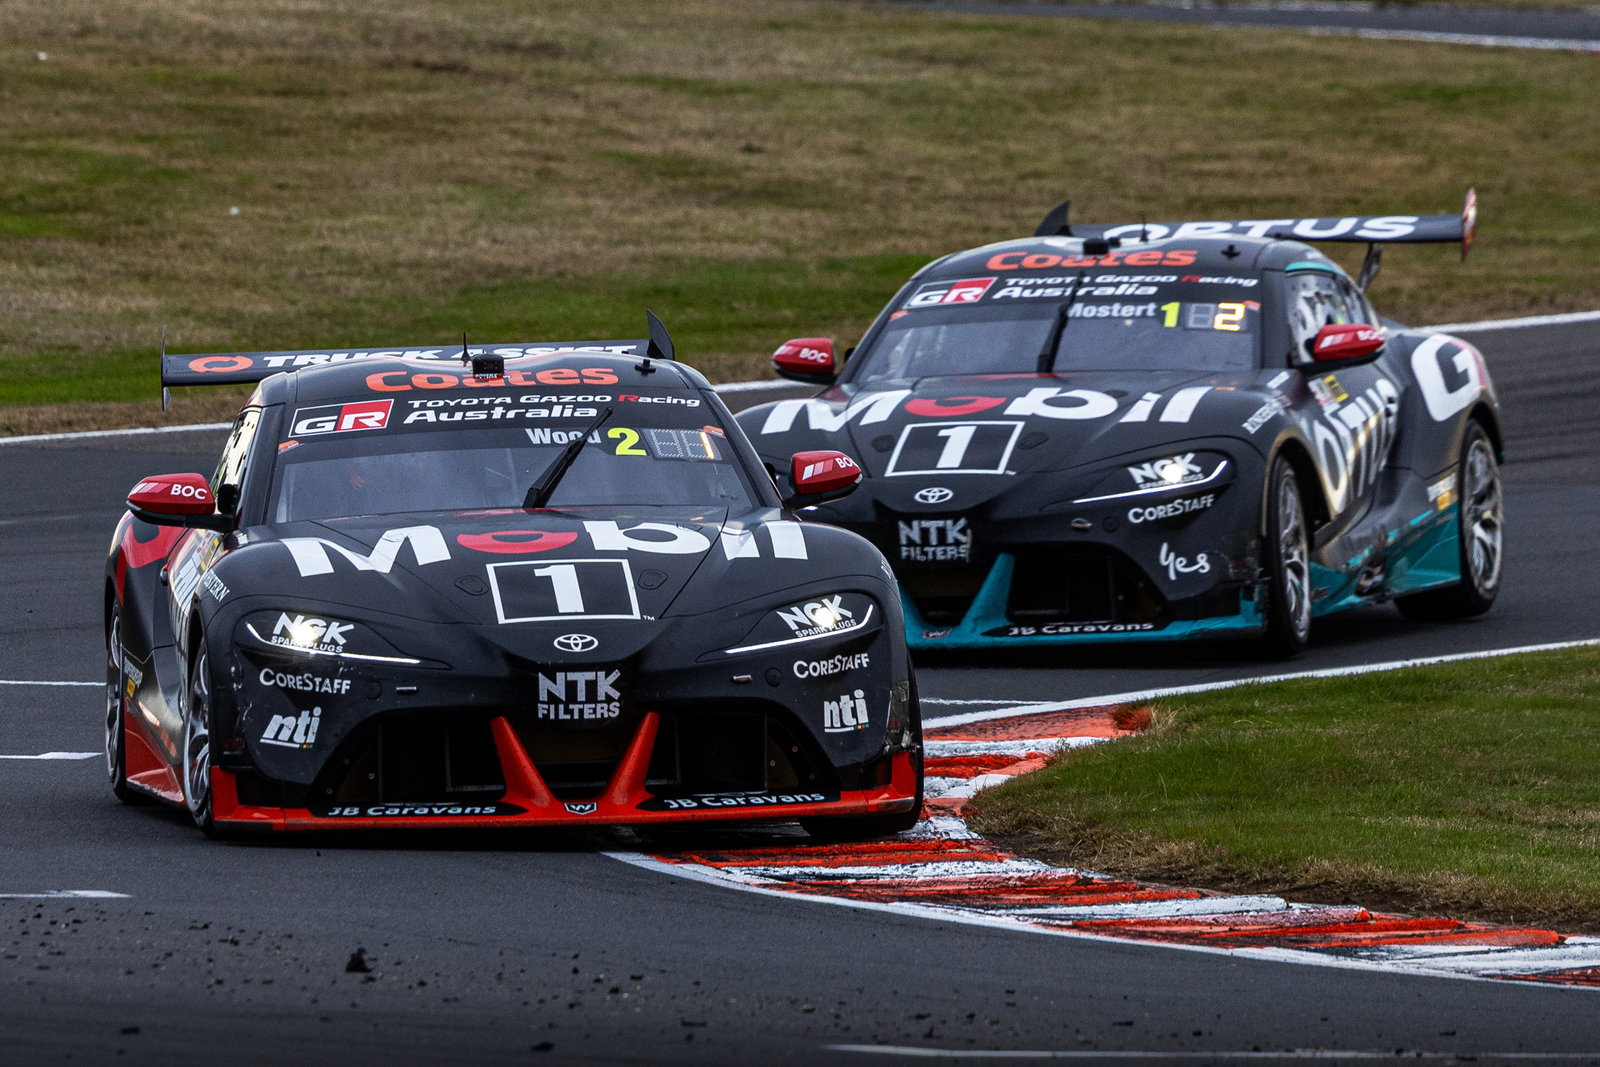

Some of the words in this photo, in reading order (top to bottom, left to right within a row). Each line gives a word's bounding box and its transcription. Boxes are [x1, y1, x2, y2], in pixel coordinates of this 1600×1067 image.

[1103, 216, 1419, 240] OPTUS
[986, 250, 1197, 271] Coates
[992, 285, 1158, 299] Australia
[1095, 275, 1177, 284] GAZOO
[1181, 275, 1259, 288] Racing
[908, 287, 982, 306] GR
[1068, 302, 1157, 318] Mostert
[1161, 302, 1180, 328] 1
[1213, 302, 1246, 331] 2
[799, 347, 829, 363] BOC
[365, 367, 619, 391] Coates
[408, 396, 512, 408] TOYOTA
[519, 394, 612, 404] GAZOO
[619, 394, 700, 408] Racing
[761, 386, 1213, 434] Mobil
[295, 411, 386, 433] GR
[404, 405, 597, 424] Australia
[525, 428, 601, 445] Wood
[607, 428, 647, 456] 2
[936, 425, 978, 469] 1
[170, 483, 208, 500] BOC
[898, 517, 967, 545] NTK
[281, 520, 808, 577] Mobil
[532, 563, 585, 613] 1
[776, 594, 853, 631] NGK
[272, 612, 355, 645] NGK
[1041, 623, 1154, 634] Caravans
[537, 670, 621, 701] NTK
[537, 701, 621, 719] FILTERS
[823, 689, 870, 729] nti
[262, 706, 322, 746] nti
[328, 806, 359, 816] JB
[366, 806, 497, 816] Caravans
[663, 799, 698, 809] JB
[701, 791, 825, 807] Caravans
